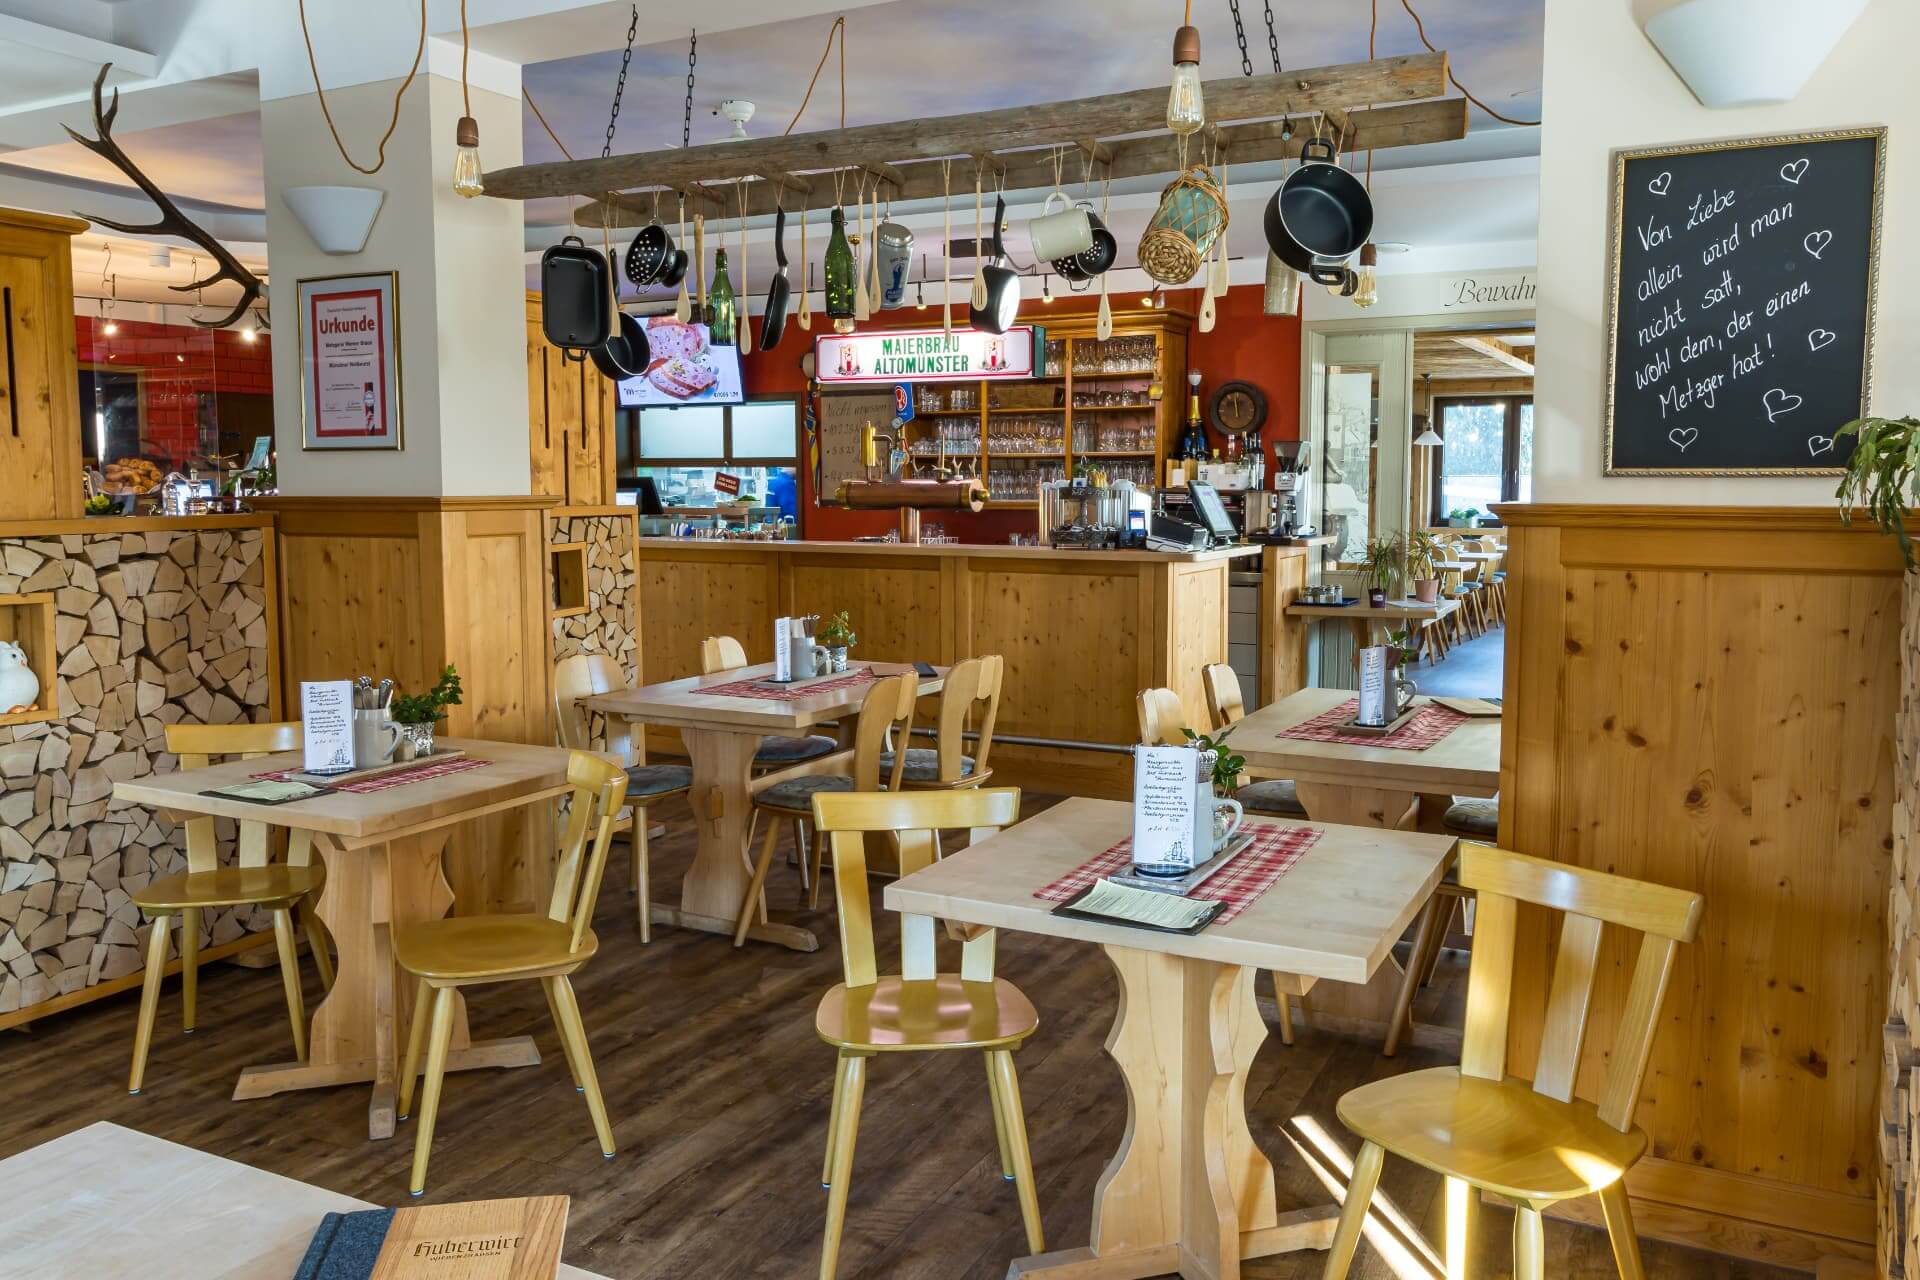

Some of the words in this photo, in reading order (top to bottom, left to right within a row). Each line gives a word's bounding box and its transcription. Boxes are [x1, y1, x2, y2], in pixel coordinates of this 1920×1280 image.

[1637, 215, 1673, 251] Von
[1686, 189, 1736, 230] Liebe
[1637, 263, 1683, 302] allein
[1703, 223, 1741, 266] wird
[1750, 202, 1793, 239] man
[319, 314, 375, 335] Urkunde
[1635, 347, 1671, 391] wohl
[1680, 334, 1723, 364] dem,
[1726, 310, 1755, 338] der
[1765, 280, 1812, 317] einen
[1638, 298, 1687, 347] nicht
[1701, 269, 1743, 309] satt,
[1658, 373, 1725, 419] Metzger
[413, 1235, 525, 1257] Huberwirt
